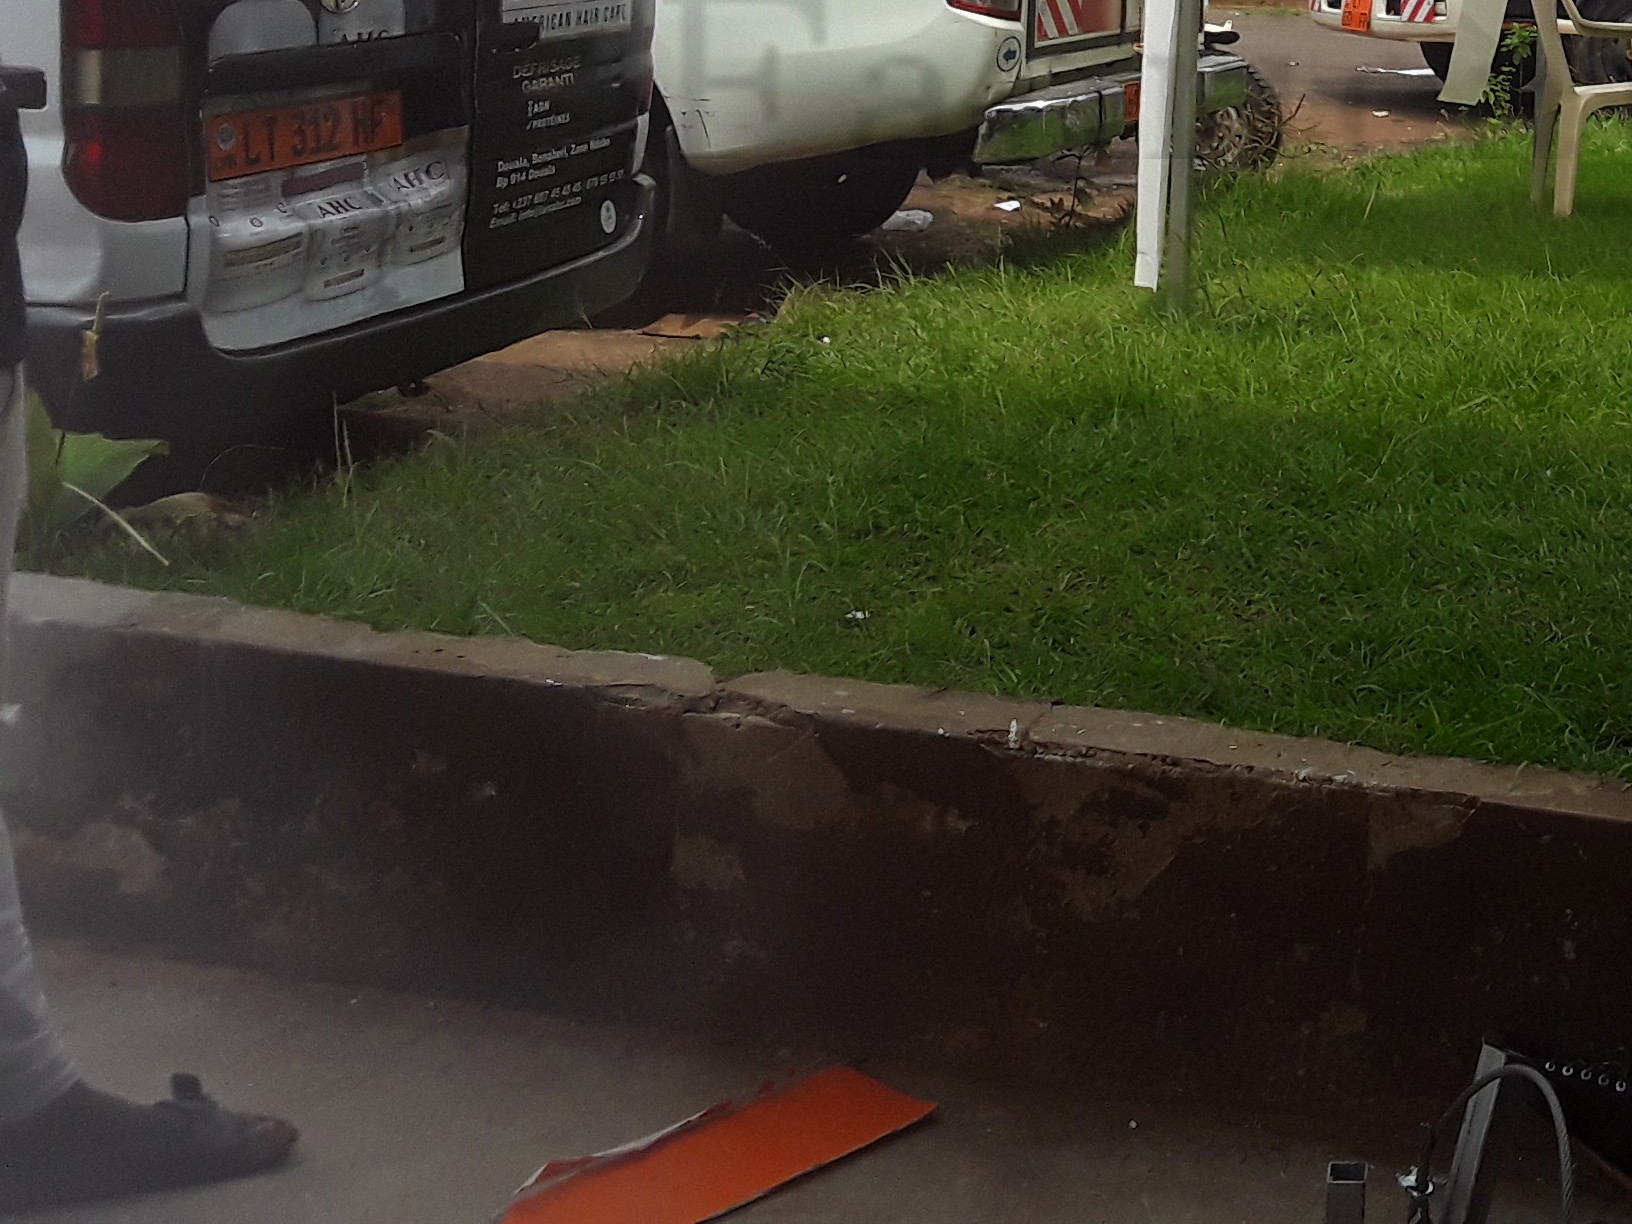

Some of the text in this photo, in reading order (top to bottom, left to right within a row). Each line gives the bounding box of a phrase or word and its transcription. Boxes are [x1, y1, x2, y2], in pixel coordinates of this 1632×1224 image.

[243, 116, 278, 165] LT
[290, 104, 343, 157] 312
[317, 196, 362, 219] AHC
